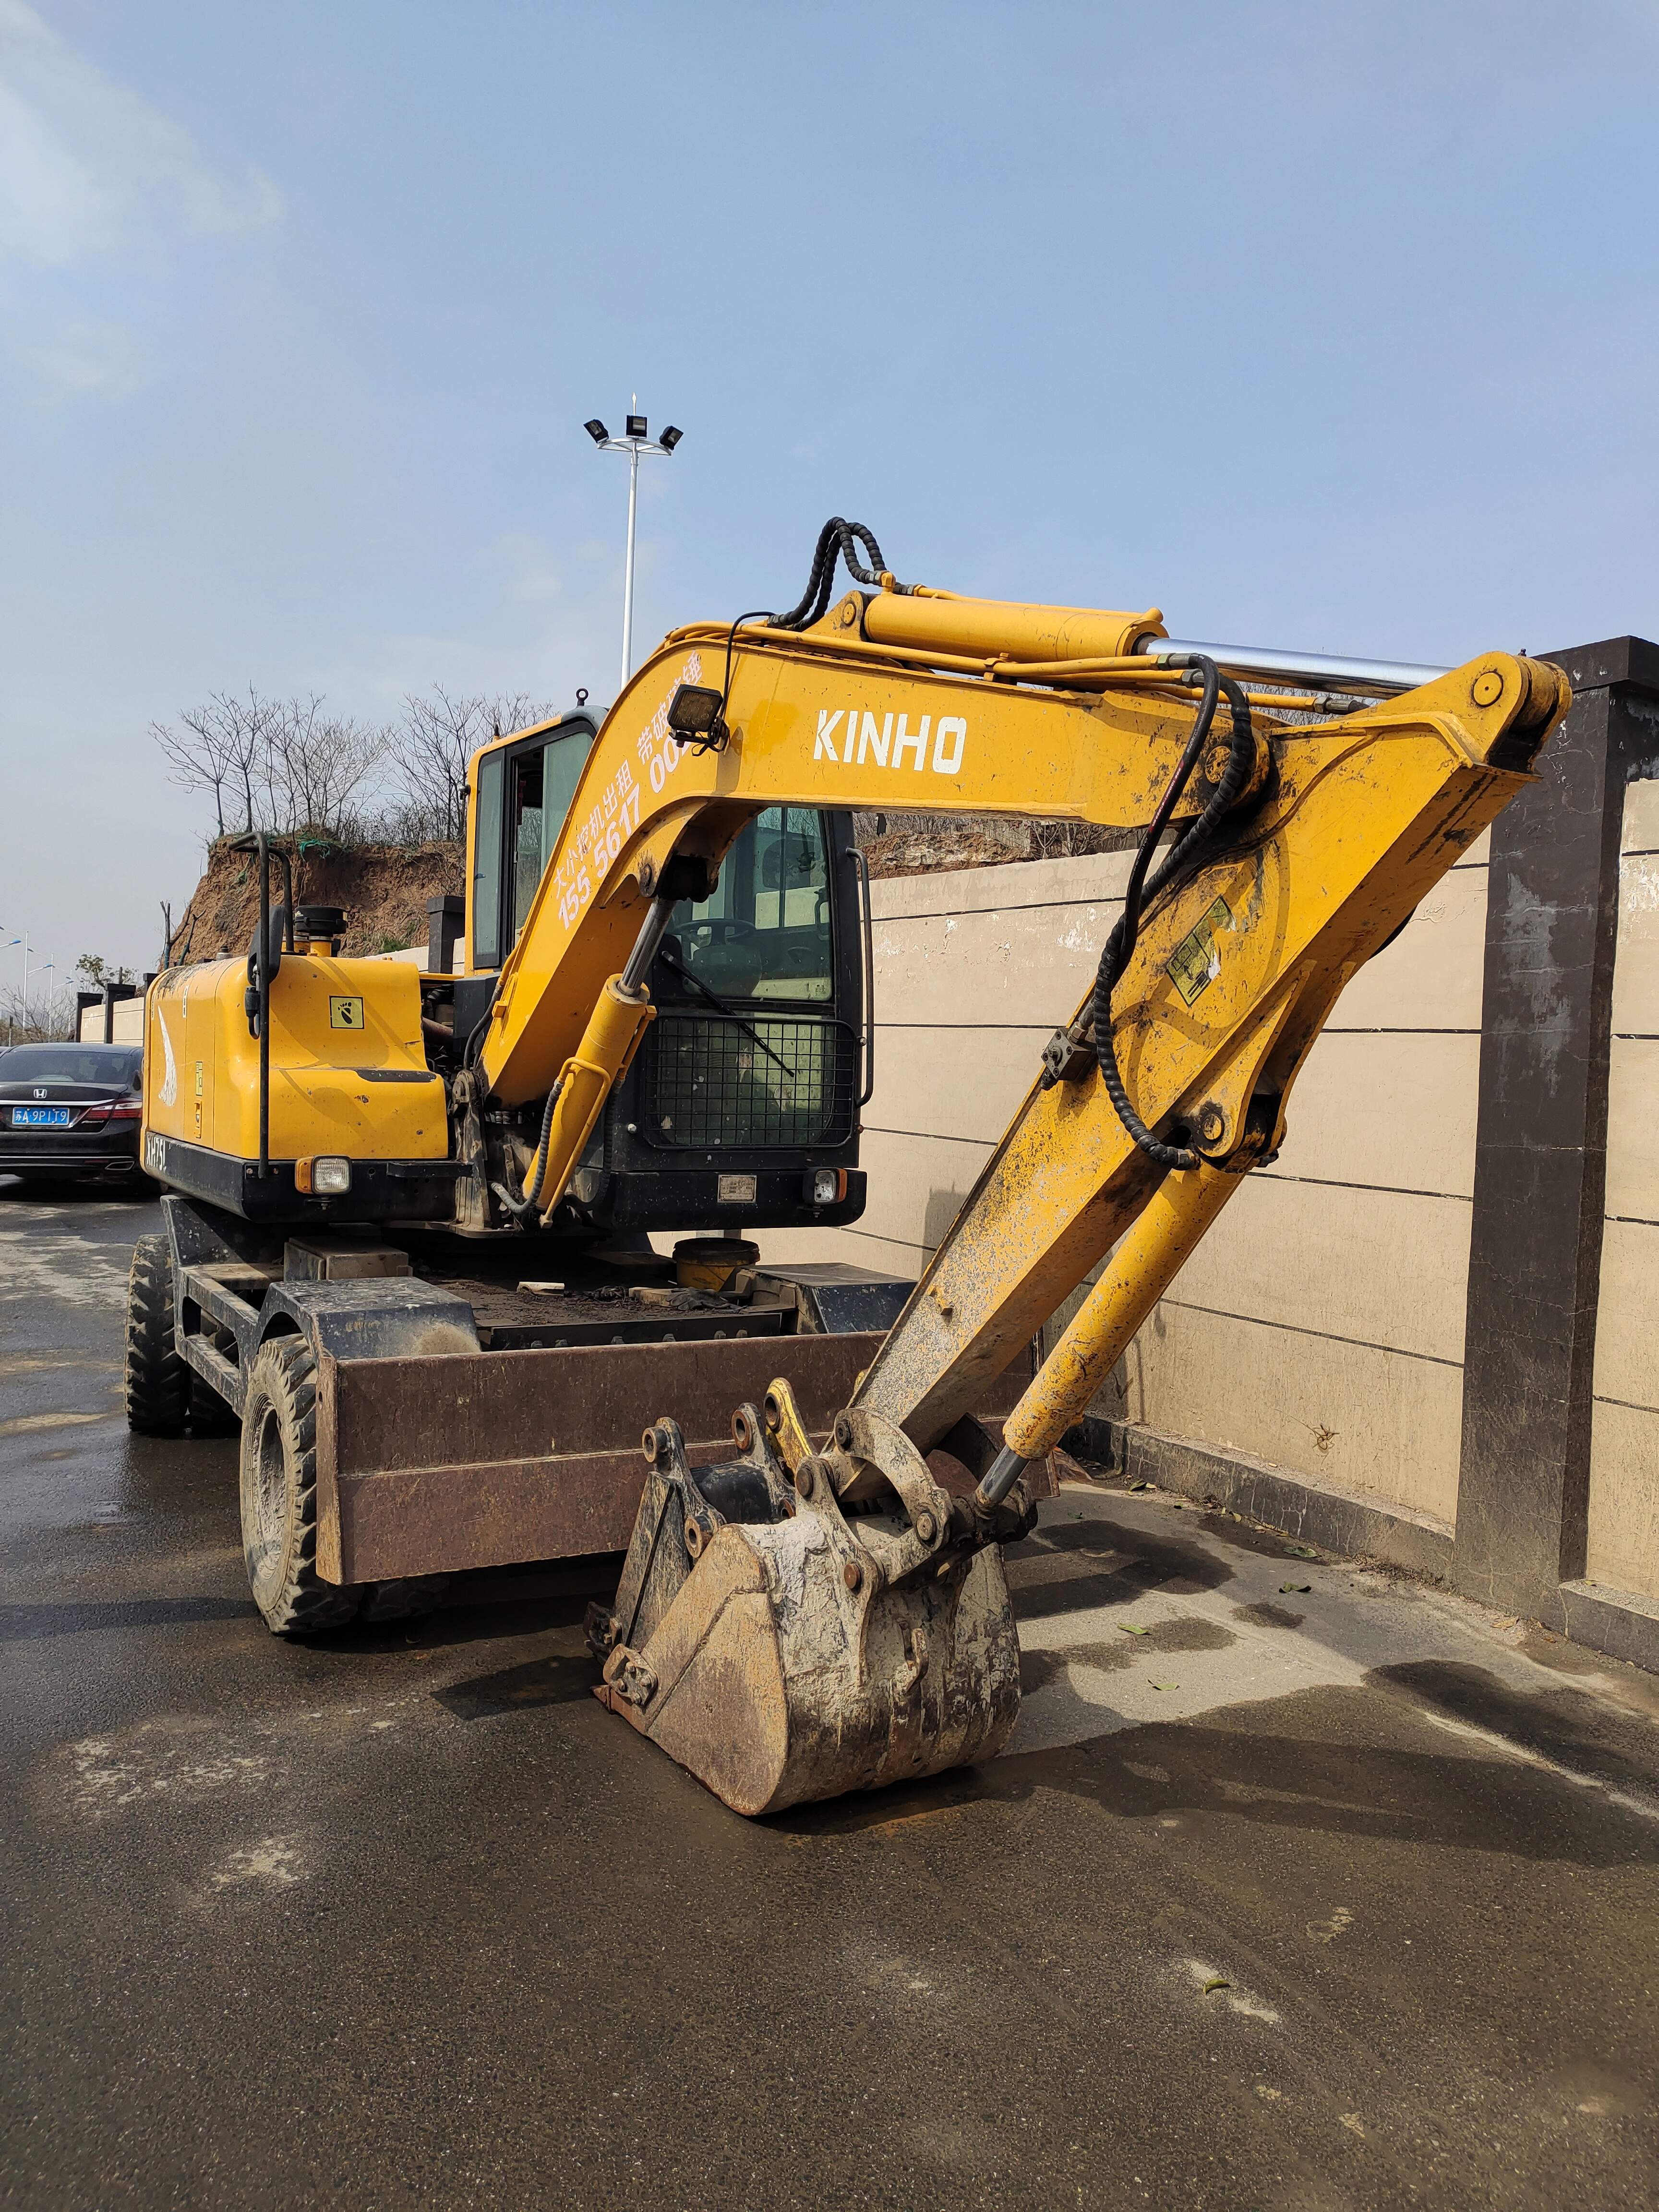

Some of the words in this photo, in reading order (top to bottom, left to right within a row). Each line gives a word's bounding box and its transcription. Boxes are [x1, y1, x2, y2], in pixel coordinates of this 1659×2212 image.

[813, 709, 967, 774] KINHO
[553, 759, 633, 899] 大小挖机出租
[558, 865, 591, 930] 155
[594, 783, 640, 878] 5617
[650, 734, 691, 793] 00
